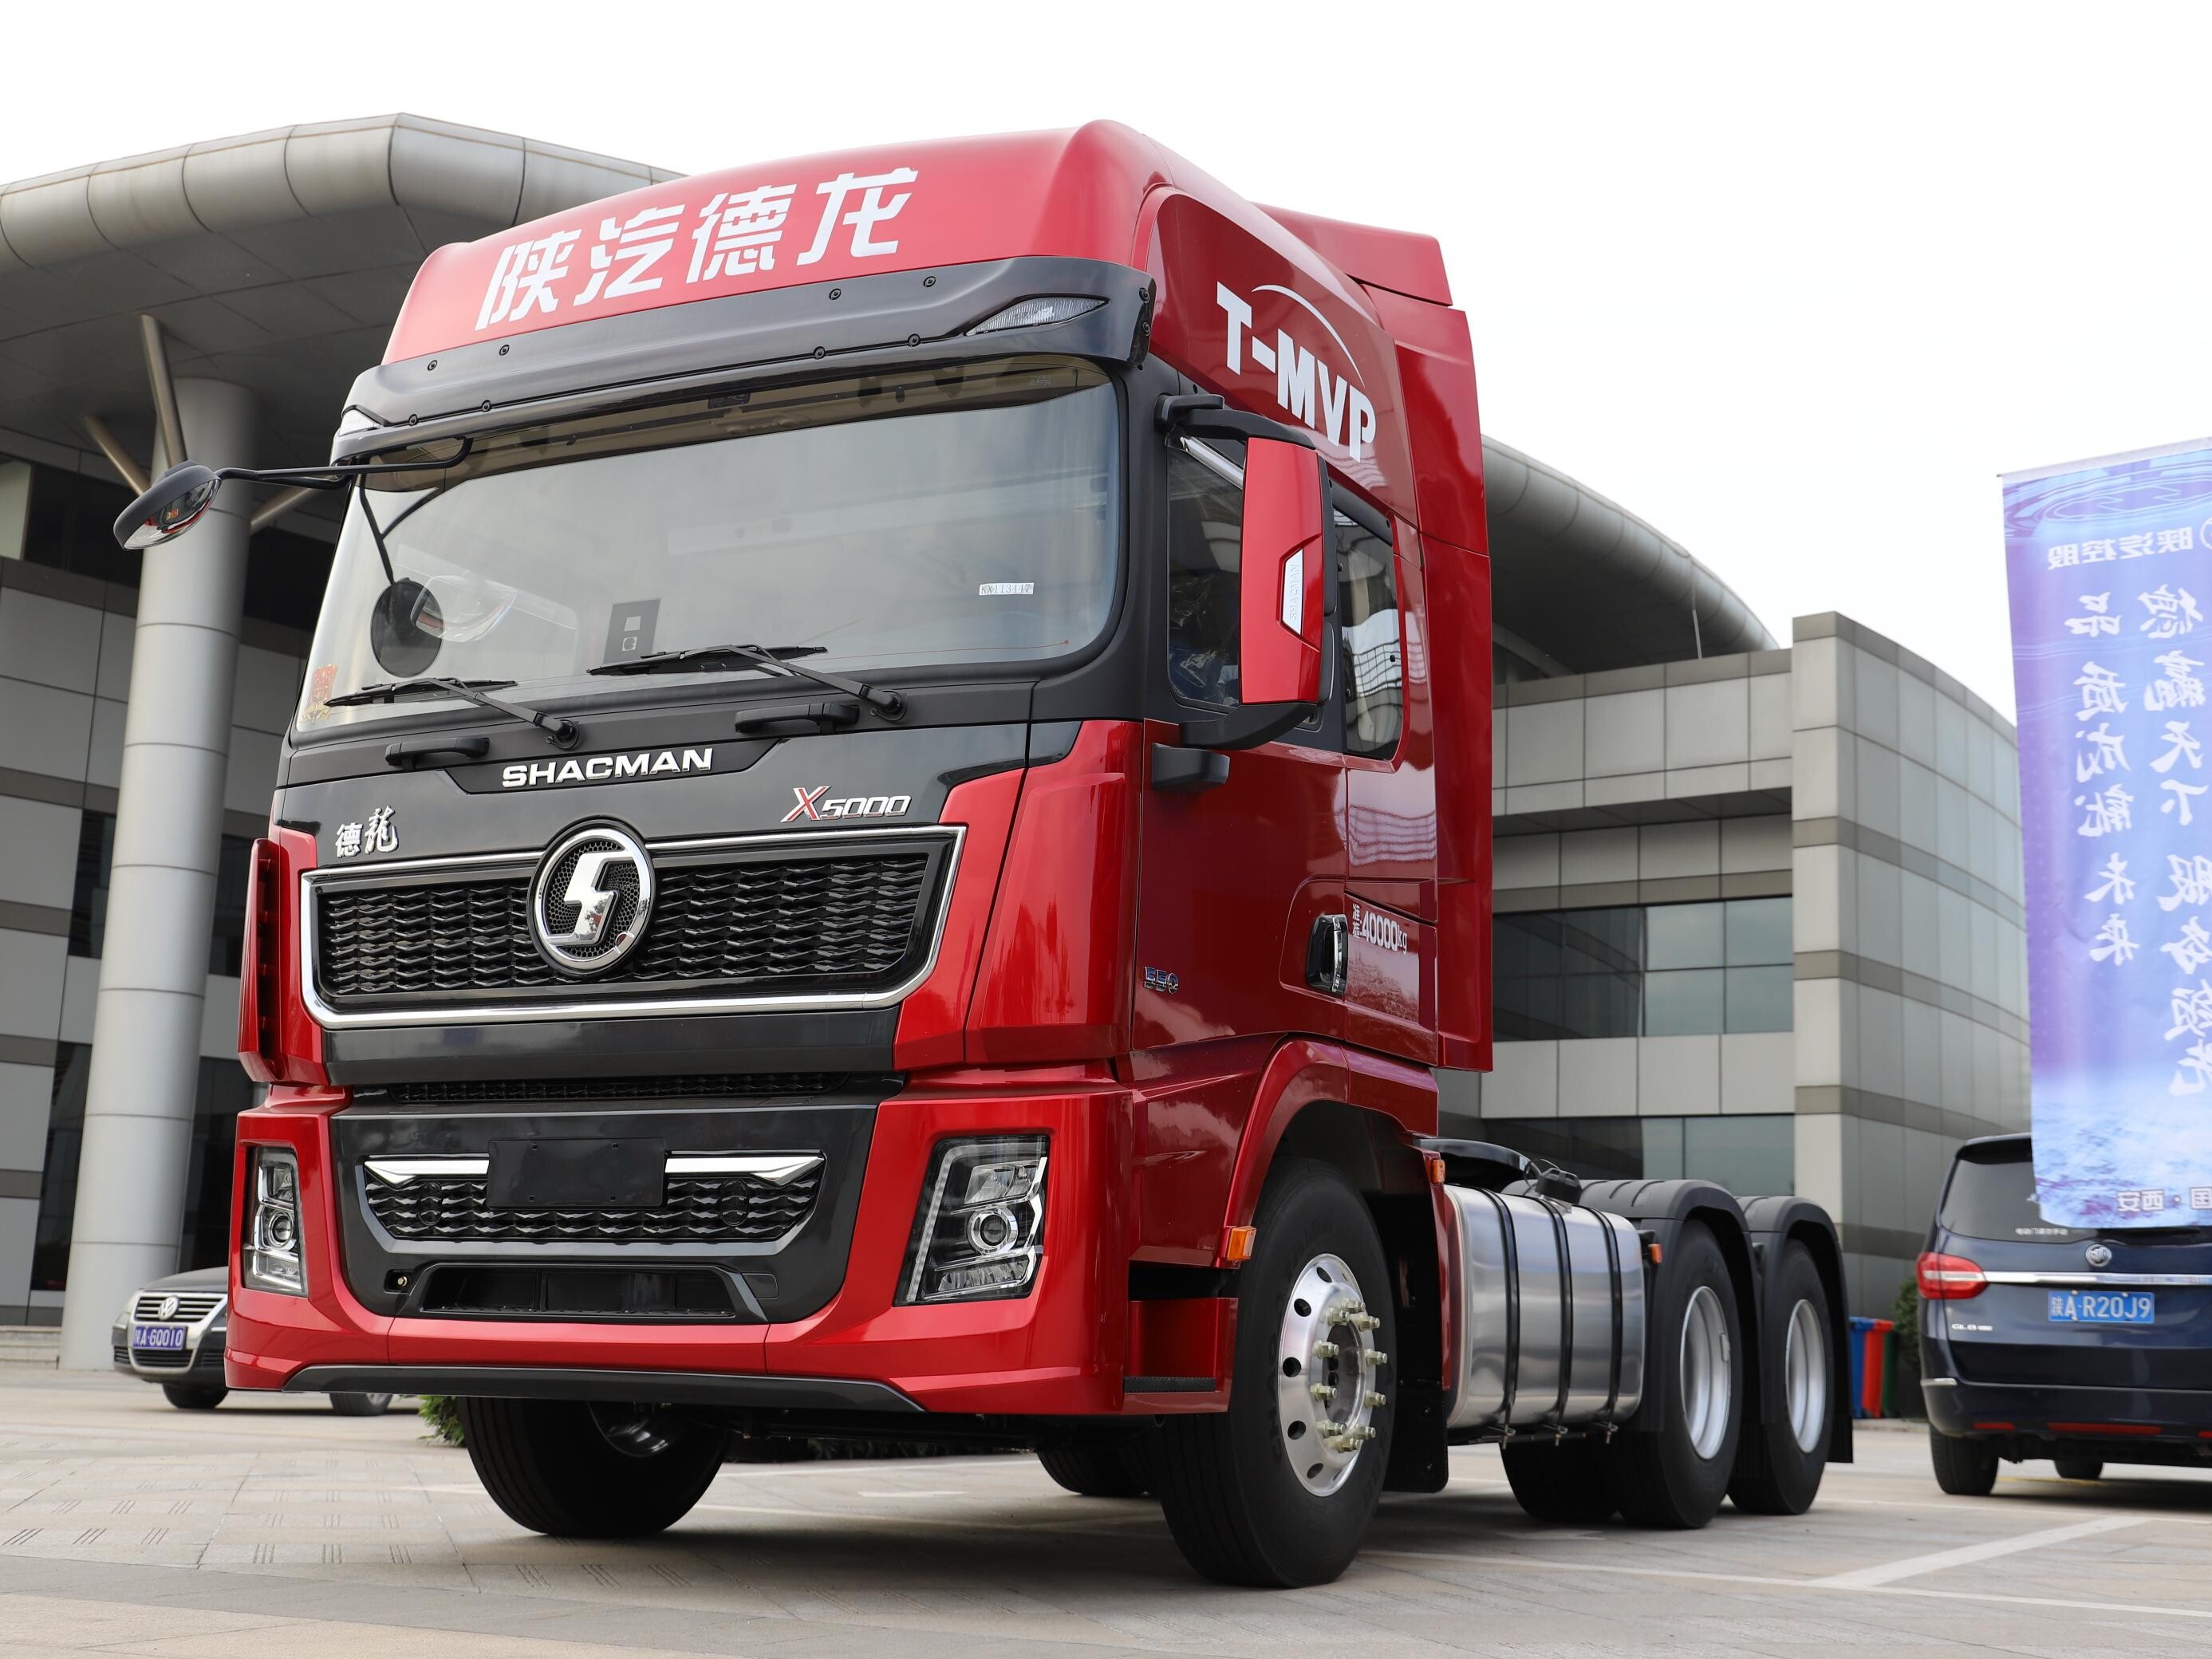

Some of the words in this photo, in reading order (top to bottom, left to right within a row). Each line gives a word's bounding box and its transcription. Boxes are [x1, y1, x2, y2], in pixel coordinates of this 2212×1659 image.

[475, 167, 919, 330] 陕汽德龙
[1216, 281, 1377, 463] T-MVP
[502, 748, 713, 788] SHACMAN
[780, 786, 912, 822] X5000
